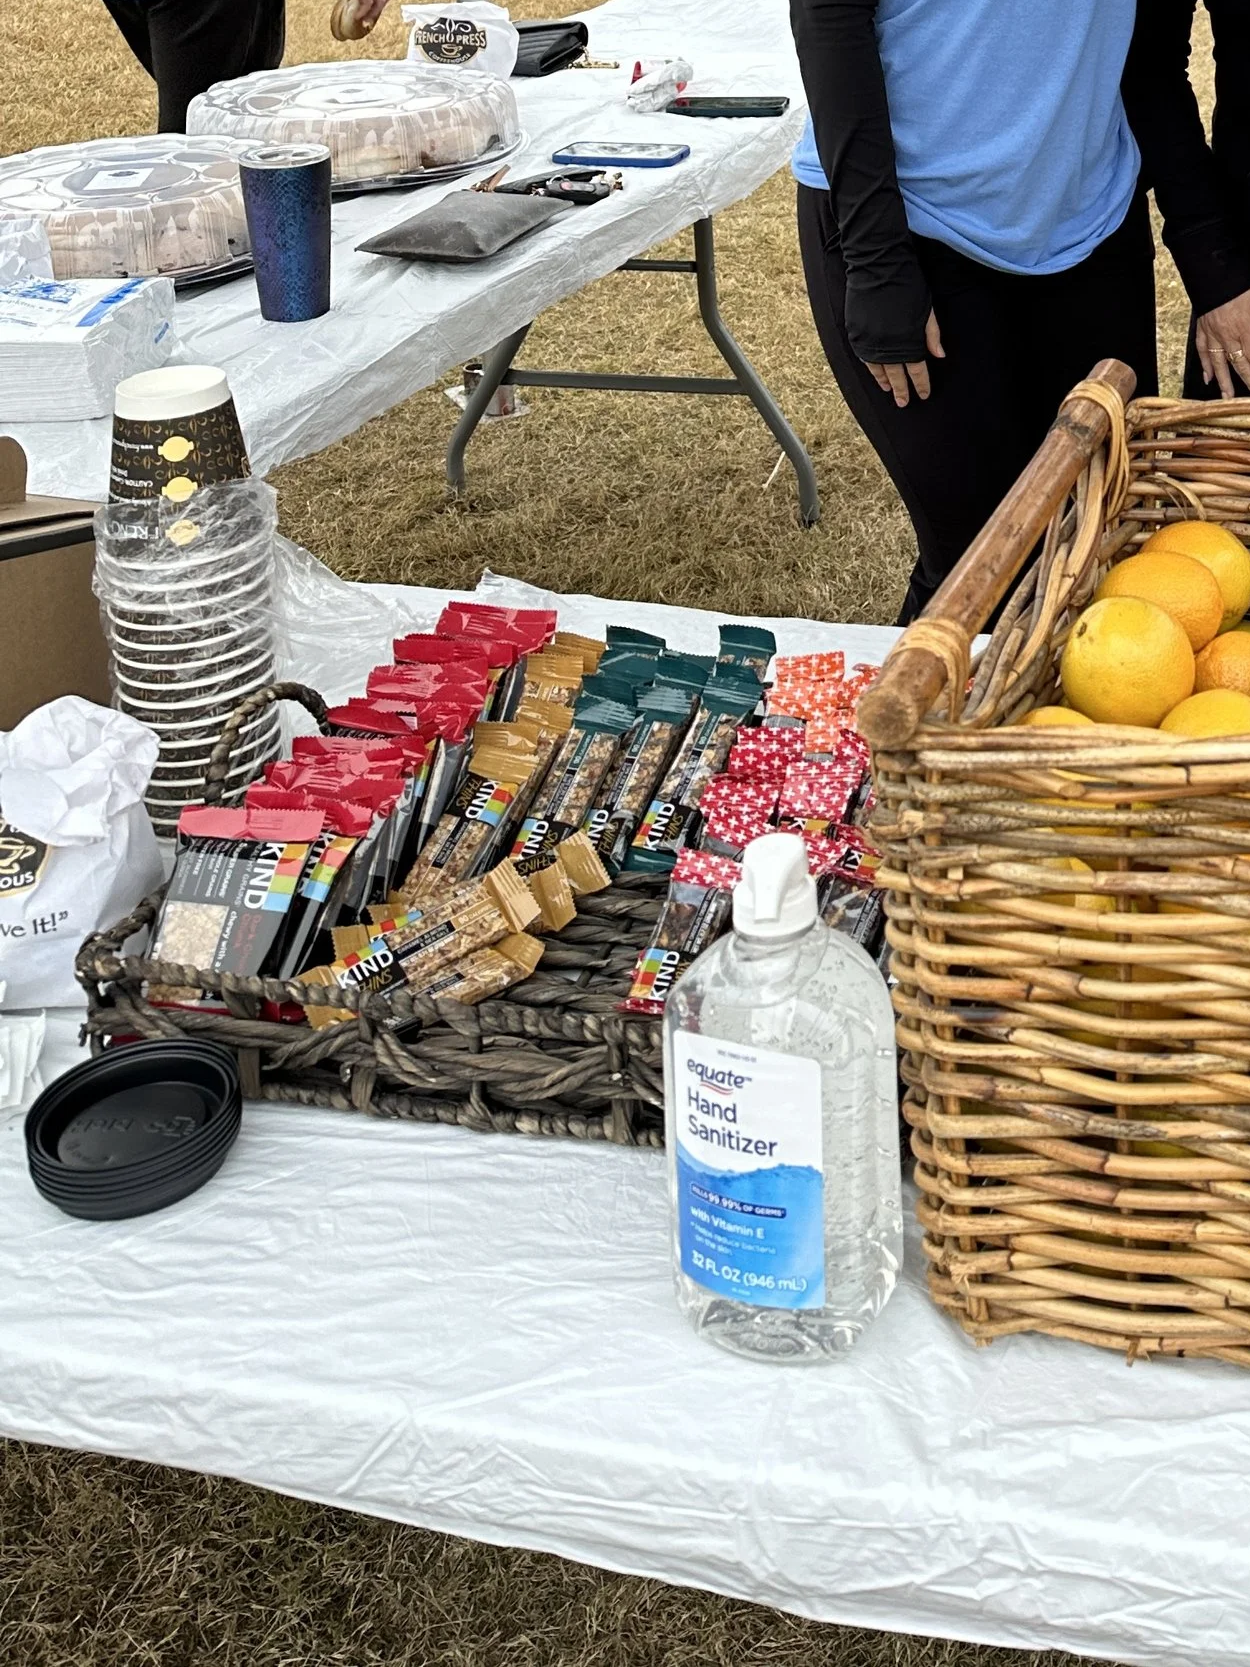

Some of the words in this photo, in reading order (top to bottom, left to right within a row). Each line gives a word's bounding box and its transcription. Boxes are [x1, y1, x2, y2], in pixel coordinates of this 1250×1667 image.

[456, 32, 486, 48] PRESS
[465, 779, 498, 819] KIND
[588, 809, 609, 847] IND
[643, 803, 675, 852] KIND
[244, 842, 288, 910] KIND
[222, 910, 238, 940] chewy
[218, 939, 229, 958] with
[336, 950, 394, 990] KIND
[650, 951, 680, 1002] KIND
[687, 1086, 737, 1124] Hand
[688, 1114, 778, 1157] Sanitizer
[690, 1205, 710, 1224] with
[711, 1214, 754, 1237] Vitamin
[756, 1227, 765, 1240] E
[705, 1258, 720, 1276] FL
[721, 1266, 741, 1283] OZ
[743, 1272, 776, 1289] (946
[778, 1279, 807, 1292] mL)
